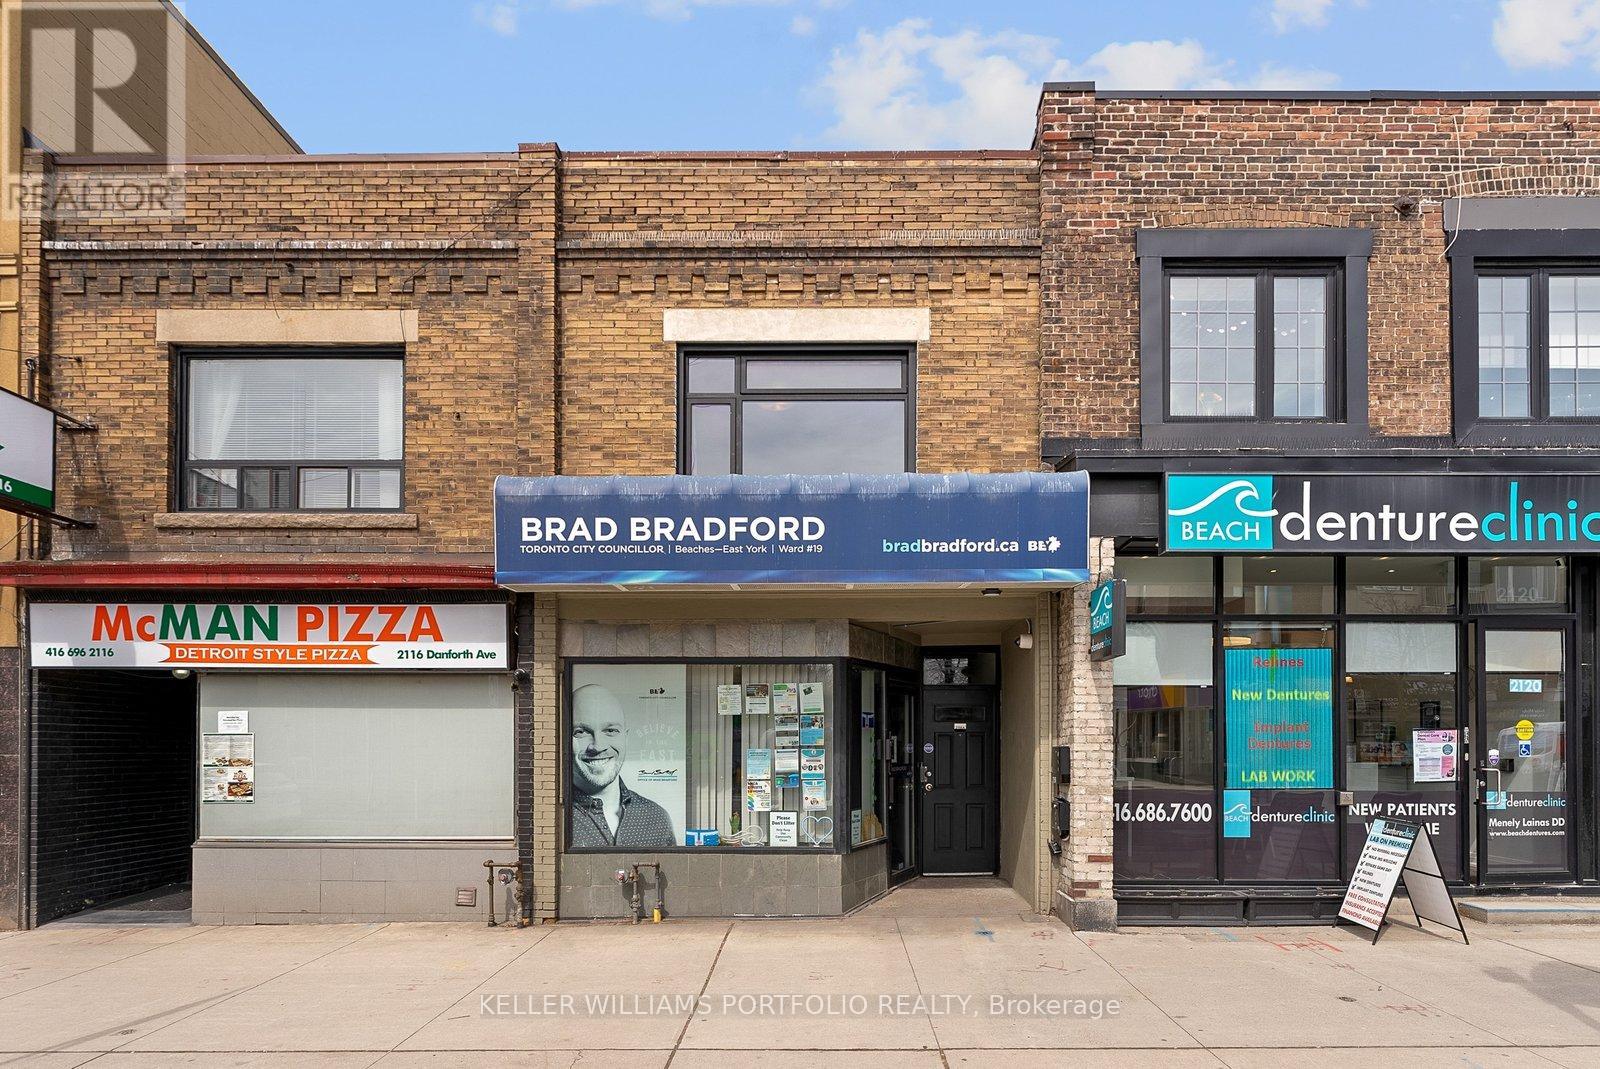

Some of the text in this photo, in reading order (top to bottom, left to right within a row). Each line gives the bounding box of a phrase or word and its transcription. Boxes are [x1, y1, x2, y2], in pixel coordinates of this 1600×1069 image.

[1279, 480, 1600, 542] dentureclinic
[521, 517, 826, 542] BRAD BRADFORD
[1181, 521, 1260, 542] BEACH
[520, 544, 570, 553] TORONTO
[572, 544, 595, 554] CITY
[598, 544, 665, 554] COUNCILLOR
[745, 543, 767, 554] York
[778, 543, 804, 554] Ward
[806, 543, 823, 554] #19
[882, 538, 1020, 553] bradbradford.ca
[92, 604, 444, 642] McMAN PIZZA
[1092, 611, 1110, 630] BEACH
[45, 647, 115, 657] 416 696 2116
[176, 646, 362, 661] DETROIT STYLE PIZZA
[397, 649, 497, 660] 2116 Danforth Ave
[1510, 680, 1541, 692] 2120
[1231, 688, 1263, 701] New
[1266, 688, 1330, 701] Dentures
[1254, 718, 1309, 735] Implant
[1248, 737, 1312, 751] Dentures
[1241, 769, 1316, 783] LAB WORK
[1506, 794, 1567, 807] dentureclinic
[1113, 803, 1213, 822] 16.686.7600
[1251, 806, 1336, 823] dentureclinic
[1348, 803, 1457, 816] NEW PATIENTS
[1489, 817, 1565, 829] Menely Lainas DD
[1379, 837, 1387, 845] ON
[1387, 839, 1411, 850] PREMISES
[1347, 891, 1358, 899] FREE
